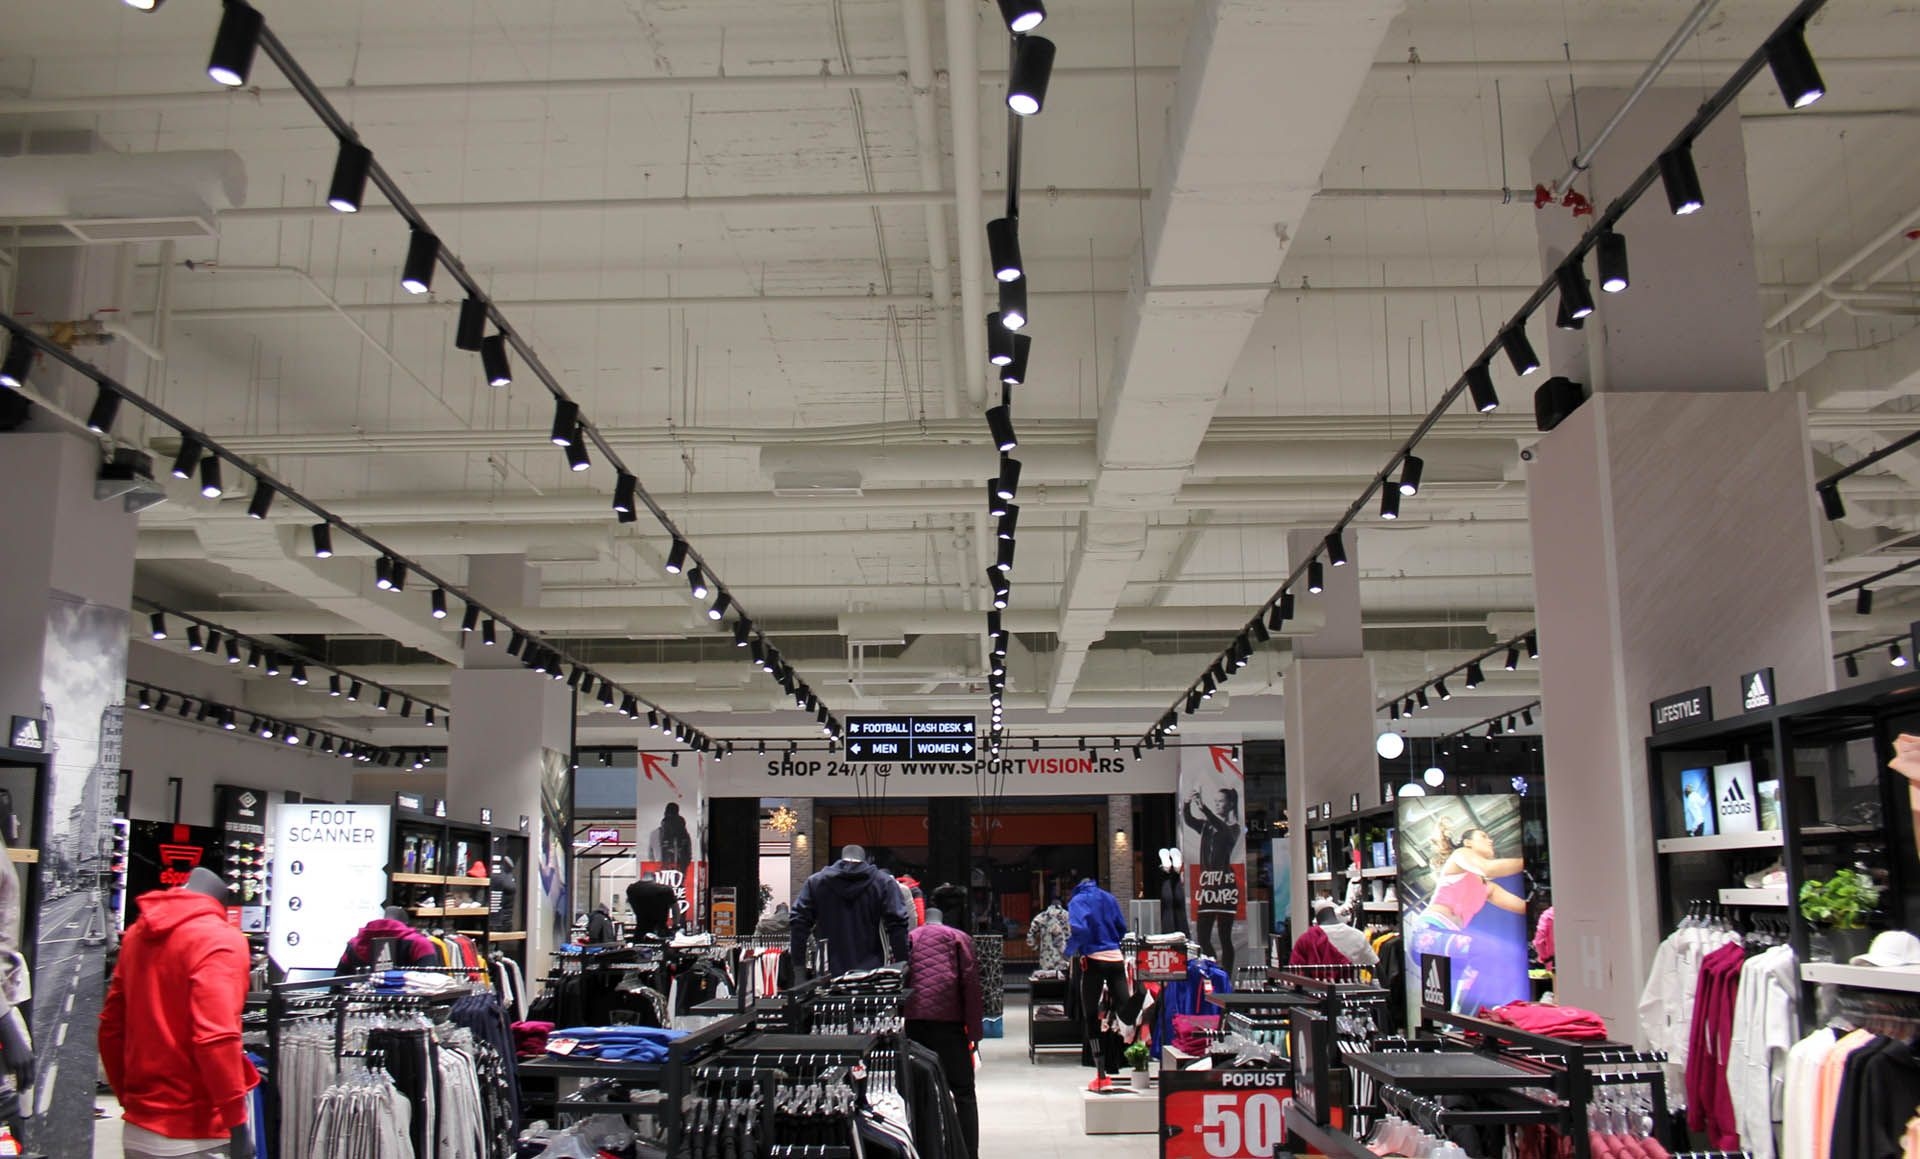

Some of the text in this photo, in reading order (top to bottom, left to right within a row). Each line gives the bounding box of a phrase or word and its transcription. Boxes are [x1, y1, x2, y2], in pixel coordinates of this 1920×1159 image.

[1746, 695, 1770, 709] adidas
[1657, 698, 1701, 724] LIFESTYLE
[863, 723, 909, 733] FOOTBALL
[914, 723, 961, 733] CASH DESK
[872, 744, 898, 754] MEN
[918, 744, 960, 754] WOMEN
[767, 761, 821, 777] SHOP
[901, 758, 1125, 776] WWW.SPORTVISION.RS
[1721, 803, 1751, 815] adidas
[310, 810, 357, 825] FOOT
[289, 827, 376, 843] SCANNER
[291, 861, 303, 875] 1
[1200, 871, 1235, 886] CITY IS
[1195, 888, 1239, 905] YOURS
[289, 897, 302, 911] 2
[287, 932, 300, 946] 3
[1424, 989, 1445, 1006] adidas
[1222, 1073, 1286, 1087] POPUST
